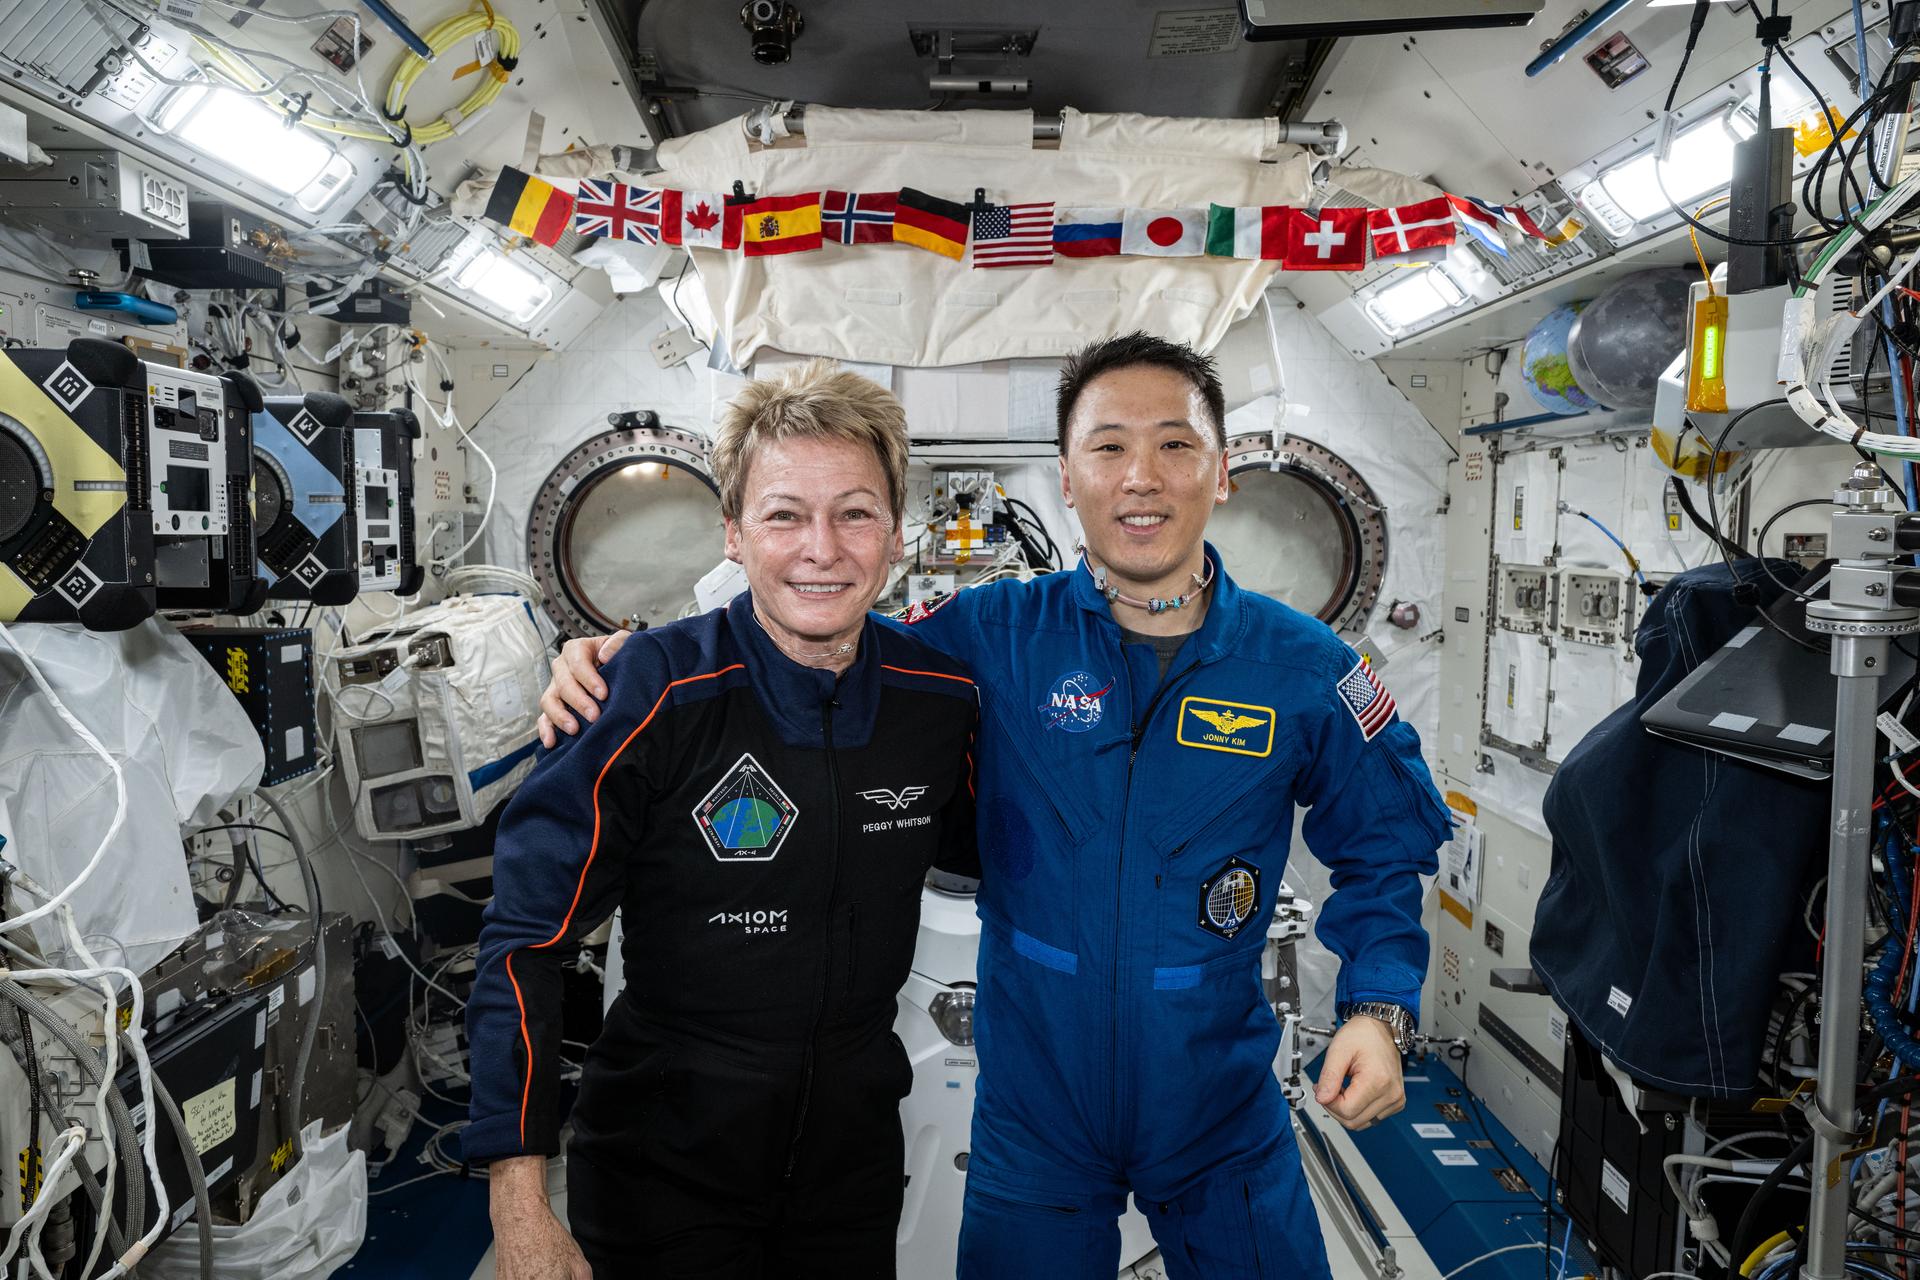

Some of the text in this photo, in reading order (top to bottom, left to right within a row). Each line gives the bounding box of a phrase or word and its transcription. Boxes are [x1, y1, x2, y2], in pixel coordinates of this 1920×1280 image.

[1051, 692, 1101, 714] NASA
[1203, 732, 1246, 747] JONNY KIM
[862, 816, 931, 833] PEGGY WHITSON
[709, 910, 787, 924] AXIOM
[1227, 918, 1236, 927] 73
[745, 925, 787, 934] SPACE
